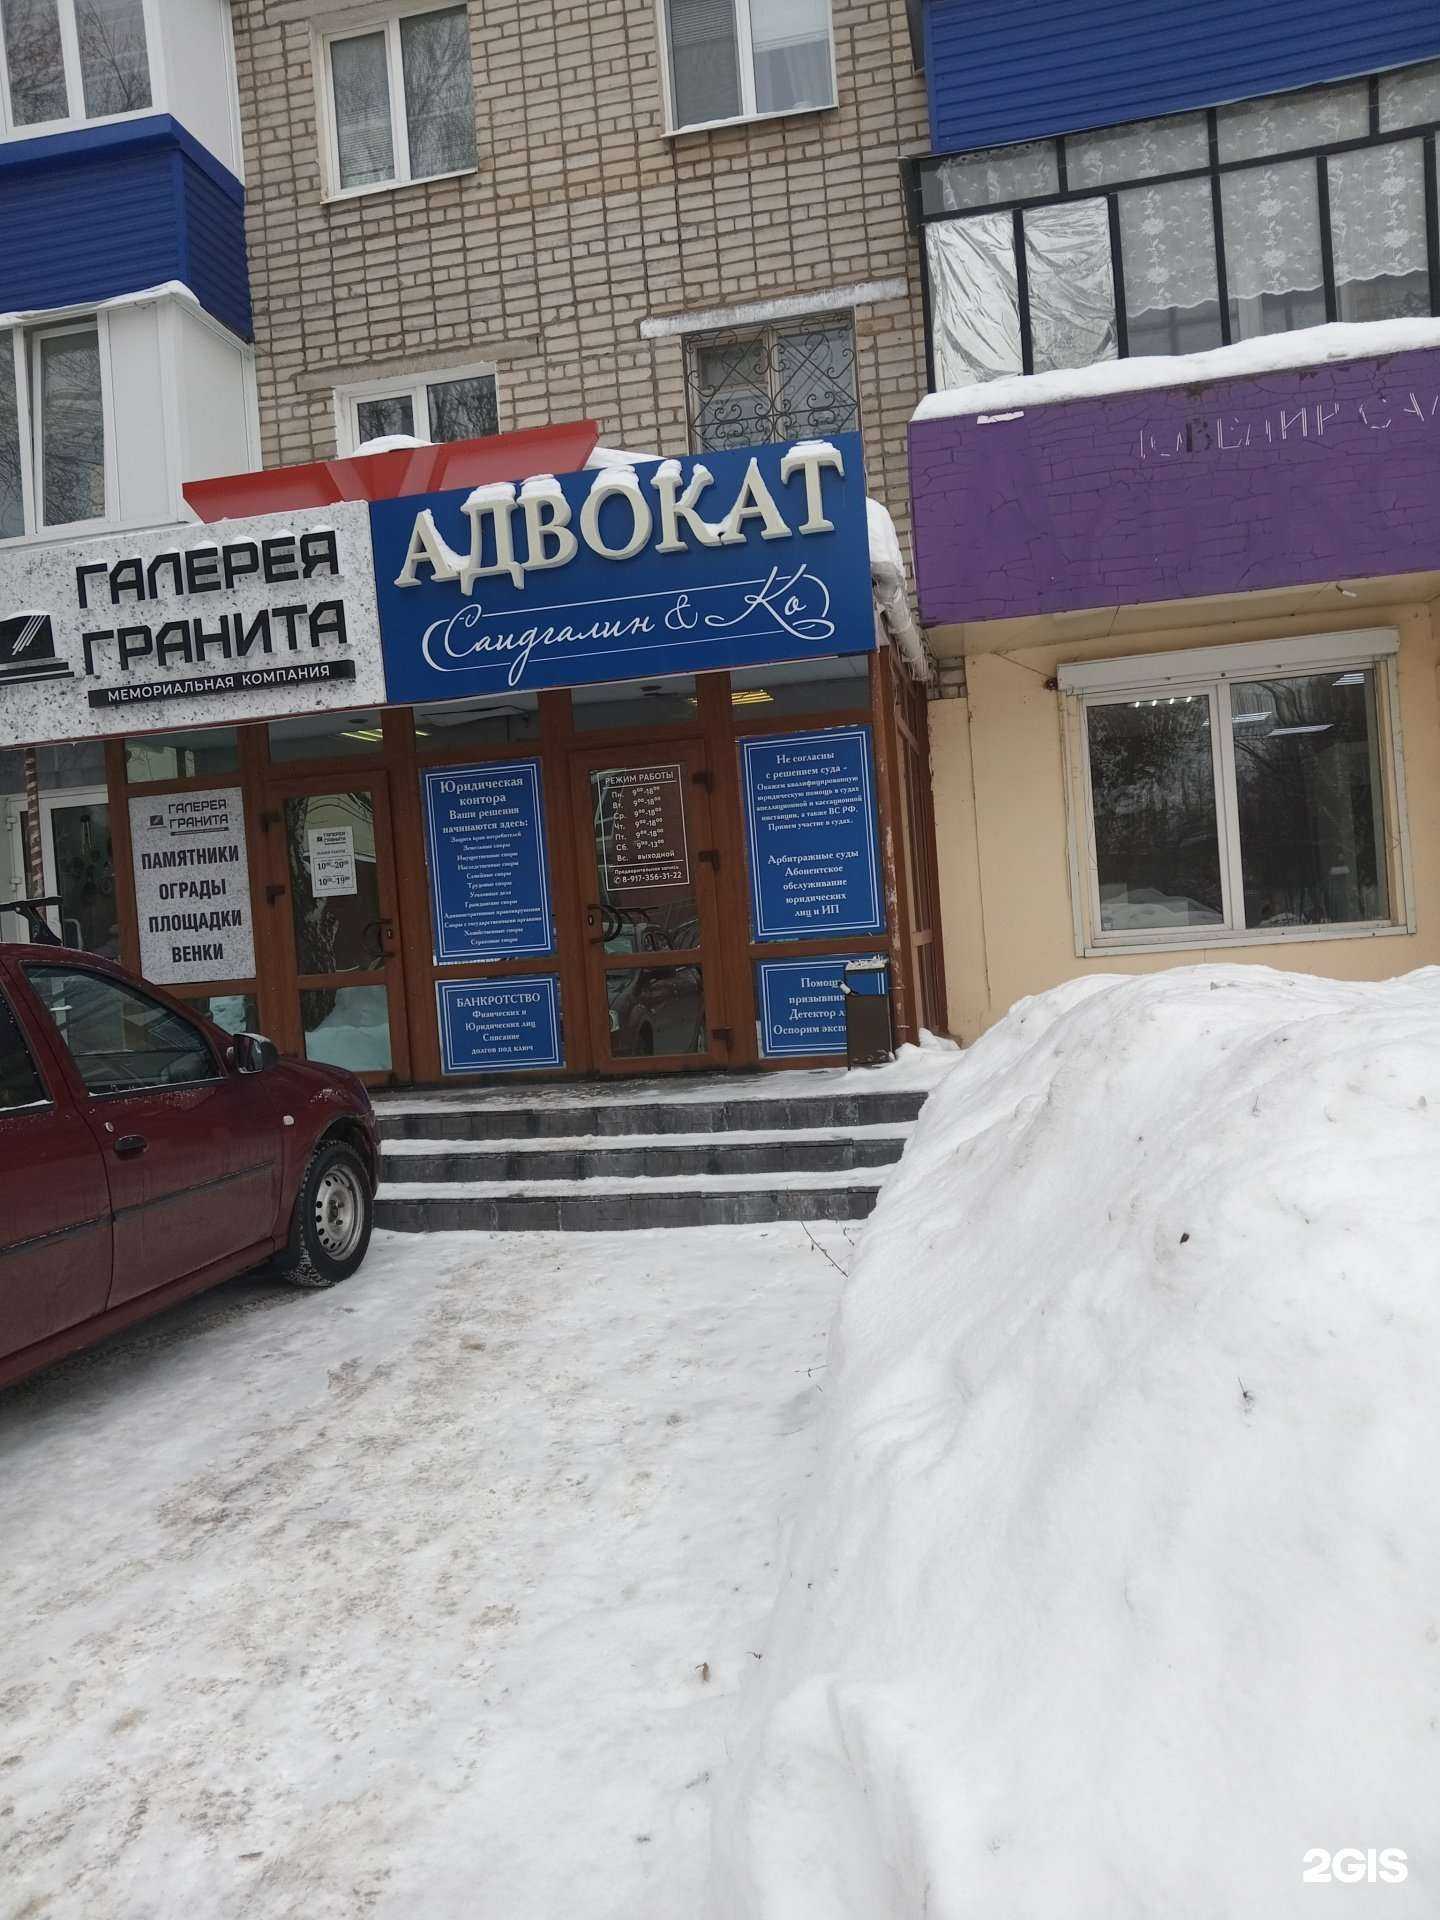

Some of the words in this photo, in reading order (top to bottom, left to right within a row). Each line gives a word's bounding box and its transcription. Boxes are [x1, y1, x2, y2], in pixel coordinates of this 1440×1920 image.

[394, 449, 845, 595] АДВОКАТ
[76, 530, 340, 609] ГАЛЕРЕЯ
[444, 603, 656, 687] Саидгалин
[665, 594, 698, 630] &
[704, 564, 835, 640] Ко
[82, 599, 348, 676] ГРАНИТА
[107, 676, 235, 702] МЕМОРИАЛЬНАЯ
[242, 665, 331, 686] КОМПАНИЯ
[776, 754, 791, 764] Не
[793, 752, 835, 763] согласны
[605, 775, 637, 785] РЕЖИМ
[639, 771, 674, 782] РАБОТЫ
[773, 768, 819, 780] решением
[820, 765, 841, 775] суда
[439, 777, 524, 794] Юридическая
[168, 799, 227, 814] ГАЛЕРЕЯ
[459, 794, 507, 806] контора
[449, 809, 476, 820] Ваши
[478, 807, 520, 819] решения
[169, 814, 229, 829] ГРАНИТА
[141, 845, 239, 870] ПАМЯТНИКИ
[767, 852, 834, 866] Арбитражные
[836, 850, 859, 860] суды
[622, 871, 682, 883] 8-917-356-31-22
[784, 865, 844, 877] Абонентское
[159, 878, 226, 900] ОГРАДЫ
[783, 879, 848, 891] обслуживание
[785, 893, 847, 905] юридических
[794, 909, 812, 918] лиц
[821, 904, 839, 915] ИП
[148, 909, 242, 933] ПЛОЩАДКИ
[172, 943, 223, 963] ВЕНКИ
[800, 977, 843, 988] Помощ
[456, 992, 541, 1008] БАНКРОТСТВО
[788, 994, 846, 1006] призывник
[472, 1009, 520, 1019] Физических
[789, 1008, 836, 1020] Детектор
[465, 1022, 520, 1032] Юридических
[521, 1021, 537, 1029] лиц
[773, 1024, 820, 1036] Оспорим
[822, 1025, 847, 1033] эксп
[482, 1033, 521, 1042] Списание
[471, 1047, 497, 1055] долгов
